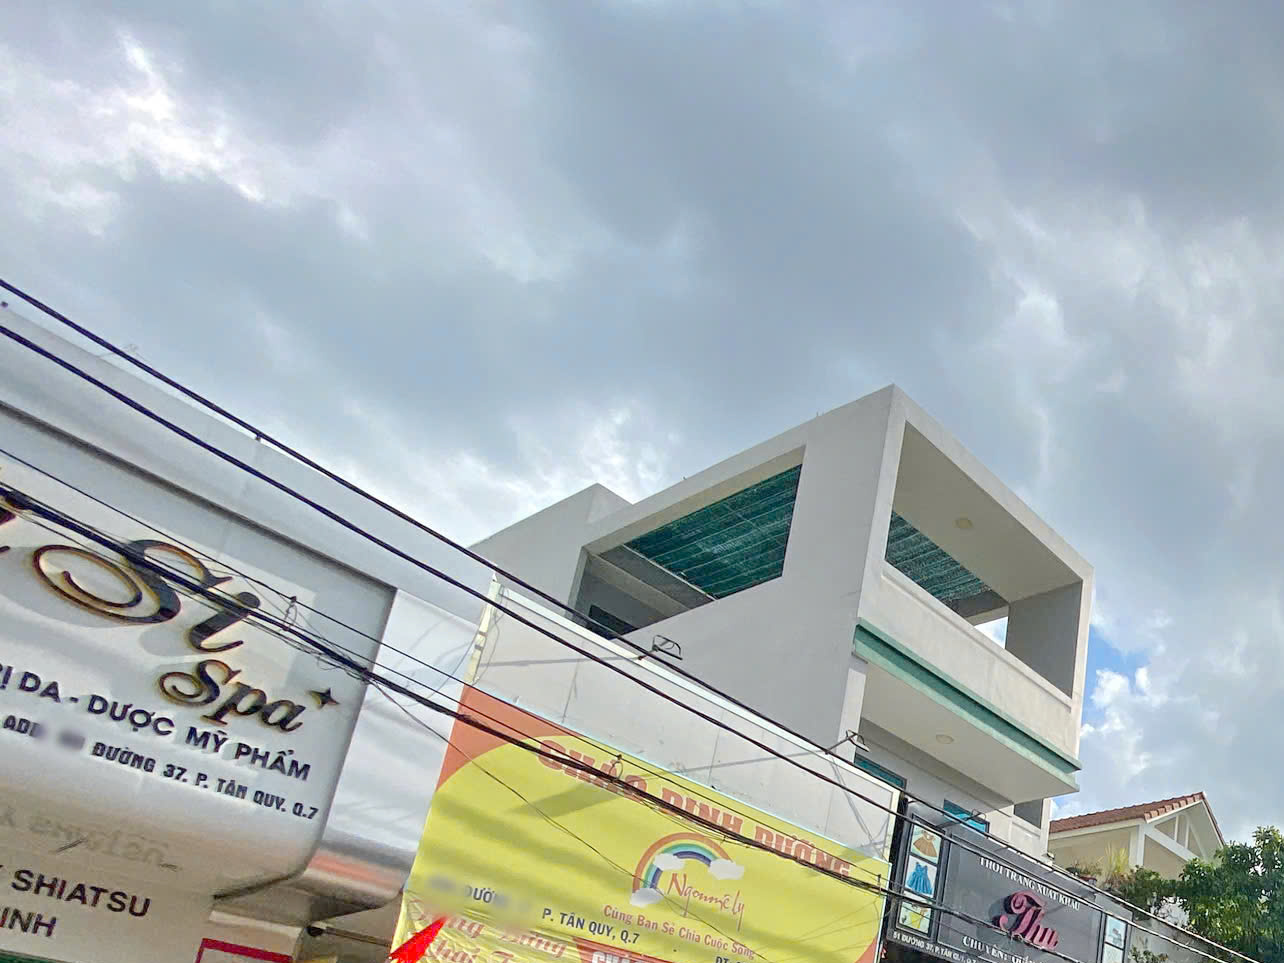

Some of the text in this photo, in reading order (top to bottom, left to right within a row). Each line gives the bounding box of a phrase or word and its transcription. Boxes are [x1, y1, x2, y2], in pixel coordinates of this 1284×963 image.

[159, 659, 306, 732] Spa
[19, 671, 61, 703] DA
[87, 694, 175, 736] DƯỢC
[185, 726, 228, 753] MỸ
[234, 742, 311, 781] PHẨM
[12, 869, 151, 917] SHIATSU
[998, 889, 1060, 951] Thu
[559, 912, 585, 930] TÂN
[620, 930, 640, 945] Q.7
[678, 926, 701, 944] Chia
